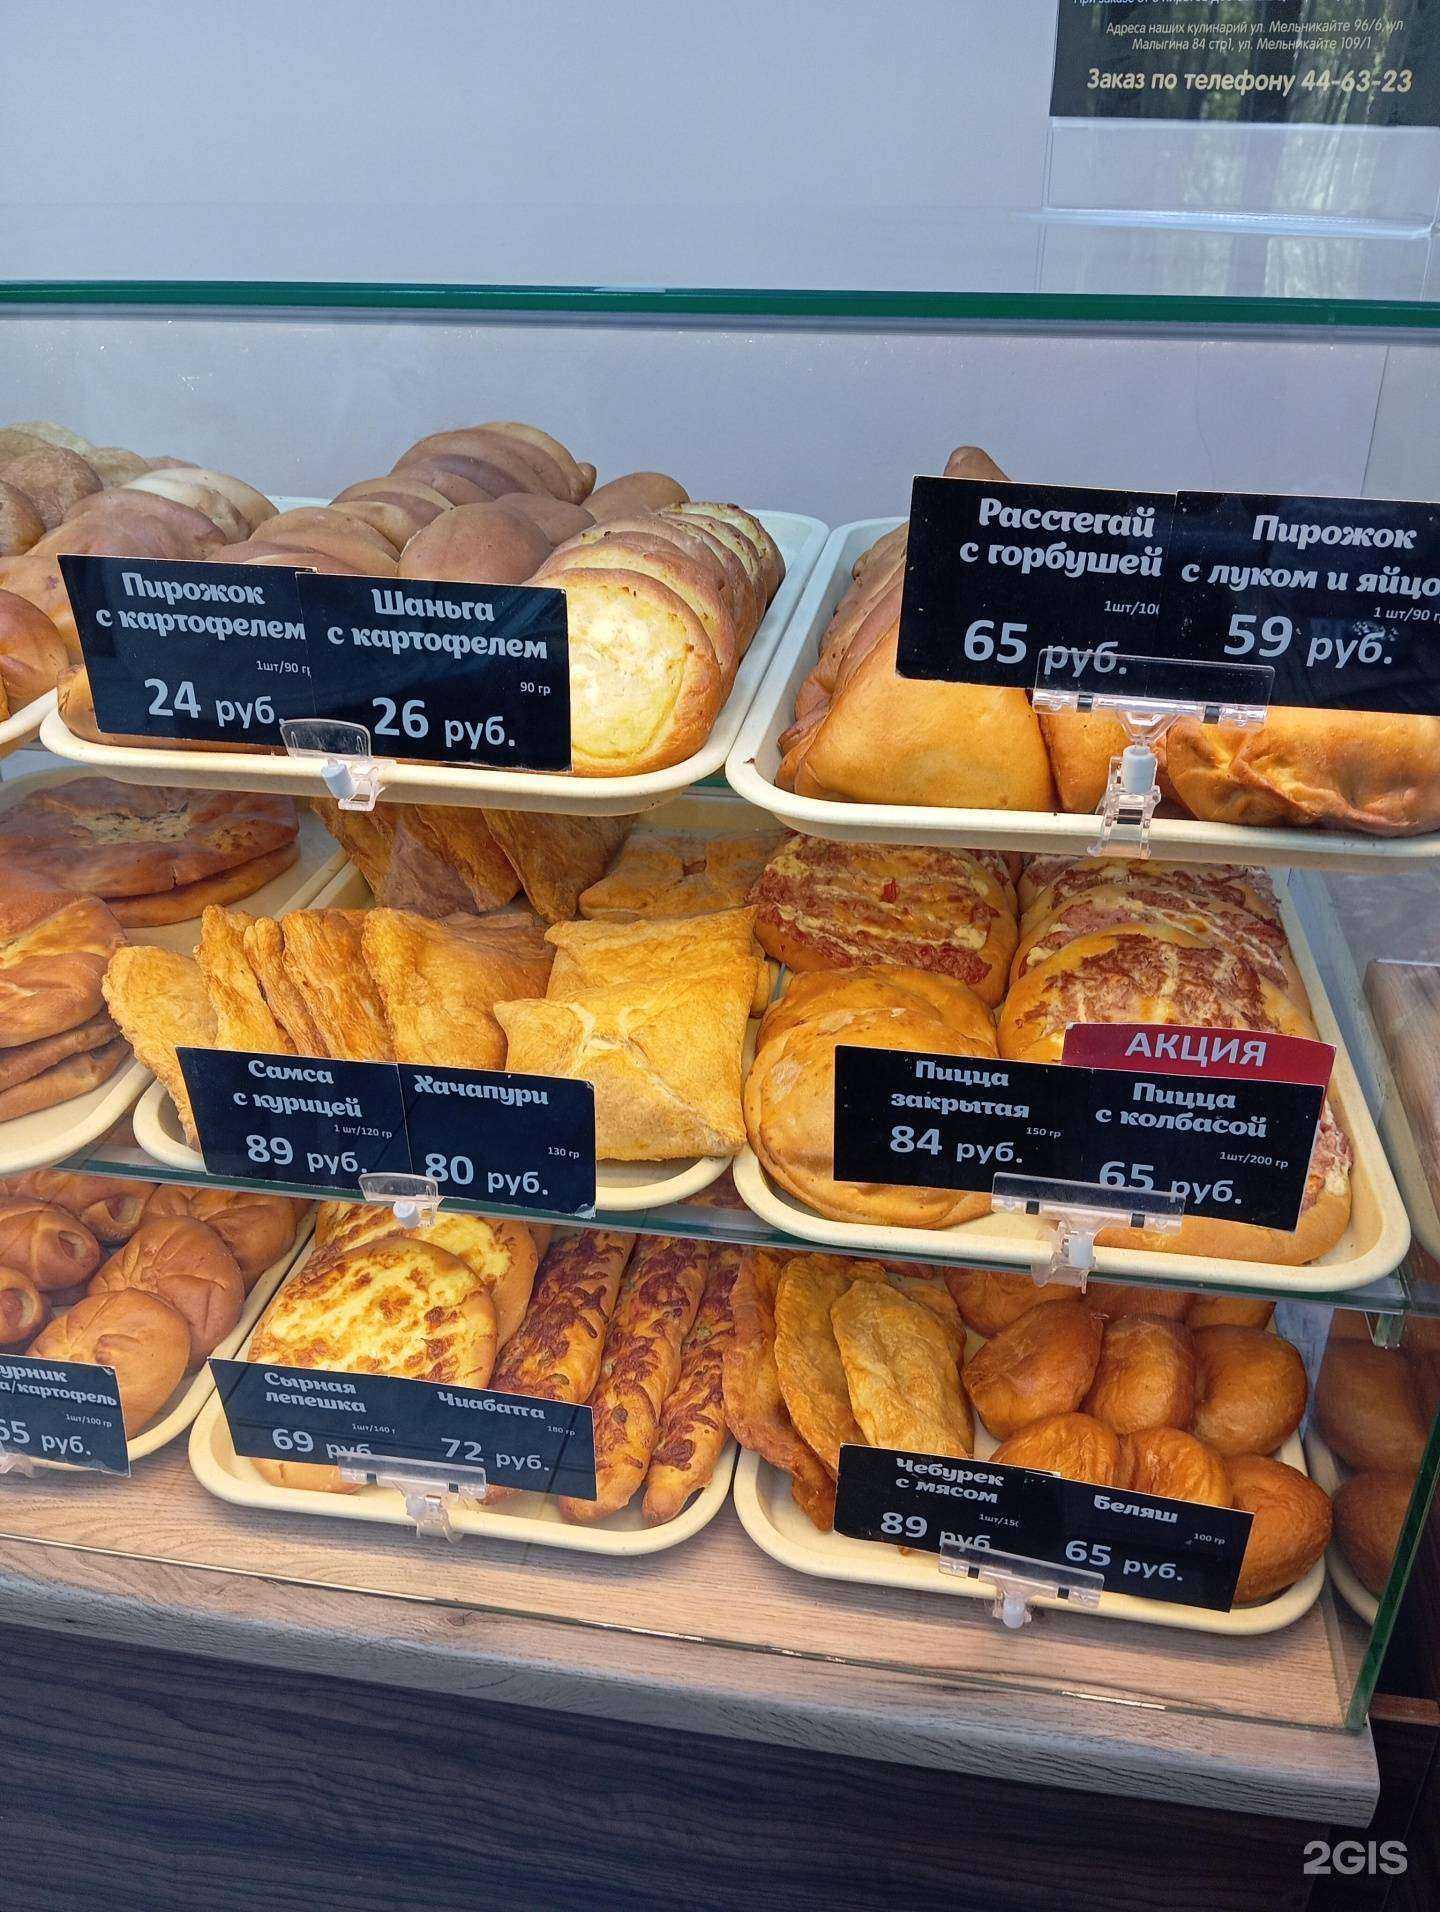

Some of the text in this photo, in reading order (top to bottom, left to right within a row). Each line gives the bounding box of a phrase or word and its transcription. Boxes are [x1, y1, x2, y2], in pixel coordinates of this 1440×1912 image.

[1106, 22, 1146, 36] Адреса
[1148, 23, 1185, 35] наших
[1187, 20, 1248, 36] кулинарий
[1249, 23, 1266, 35] ул.
[1269, 19, 1350, 34] Мельникайте
[1132, 37, 1192, 50] Малыгина
[1192, 37, 1206, 50] 84
[1208, 37, 1234, 52] стр1,
[1256, 36, 1337, 50] Мельникайте
[1341, 36, 1371, 50] 109/1
[1087, 67, 1413, 97] Заказ по телефону 44-63-23
[978, 497, 1156, 538] Расстегай
[1252, 514, 1417, 549] Пирожок
[959, 541, 1164, 578] с горбушей
[121, 572, 266, 605] Пирожок
[1181, 563, 1200, 583] с
[1207, 564, 1318, 592] луком
[1327, 571, 1348, 591] и
[371, 588, 495, 622] Шаньга
[1373, 606, 1381, 618] 1
[1385, 607, 1430, 622] шт/90
[96, 609, 306, 641] с картофелем
[327, 626, 548, 660] с картофелем
[964, 619, 1127, 678] 65 руб.
[1223, 613, 1393, 669] 59 руб.
[256, 660, 299, 674] 1шт/90
[520, 681, 551, 696] 90 гр
[144, 678, 286, 729] 24 руб.
[372, 697, 516, 750] 26 руб.
[1125, 1032, 1267, 1068] АКЦИЯ
[248, 1059, 334, 1085] Самса
[915, 1060, 1009, 1088] Пицца
[233, 1092, 363, 1118] с курицей
[413, 1074, 549, 1107] Хачапури
[1132, 1082, 1236, 1110] Пицца
[890, 1093, 1030, 1119] закрытая
[334, 1124, 393, 1140] 1 шт/120 гр
[1026, 1126, 1062, 1139] 150 гр
[1095, 1109, 1267, 1138] с колбасой
[246, 1134, 368, 1175] 89 руб.
[548, 1146, 580, 1160] 130 гр
[889, 1125, 1023, 1165] 84 руб.
[425, 1153, 549, 1196] 80 руб.
[1219, 1151, 1289, 1170] 1шт/200 гр
[1099, 1160, 1242, 1205] 65 руб.
[264, 1371, 357, 1394] Сырная
[265, 1391, 367, 1413] лепешка
[437, 1391, 546, 1420] Чиабатта
[65, 1413, 112, 1429] 1шт/100 гр
[0, 1419, 92, 1456] 65 руб.
[272, 1428, 314, 1453] 69
[440, 1437, 550, 1472] 72 руб.
[896, 1457, 1005, 1487] Чебурек
[895, 1476, 998, 1504] с мясом
[1093, 1494, 1178, 1523] Беляш
[880, 1512, 928, 1538] 89
[1194, 1532, 1226, 1545] 100 гр
[1065, 1540, 1184, 1581] 65 руб.
